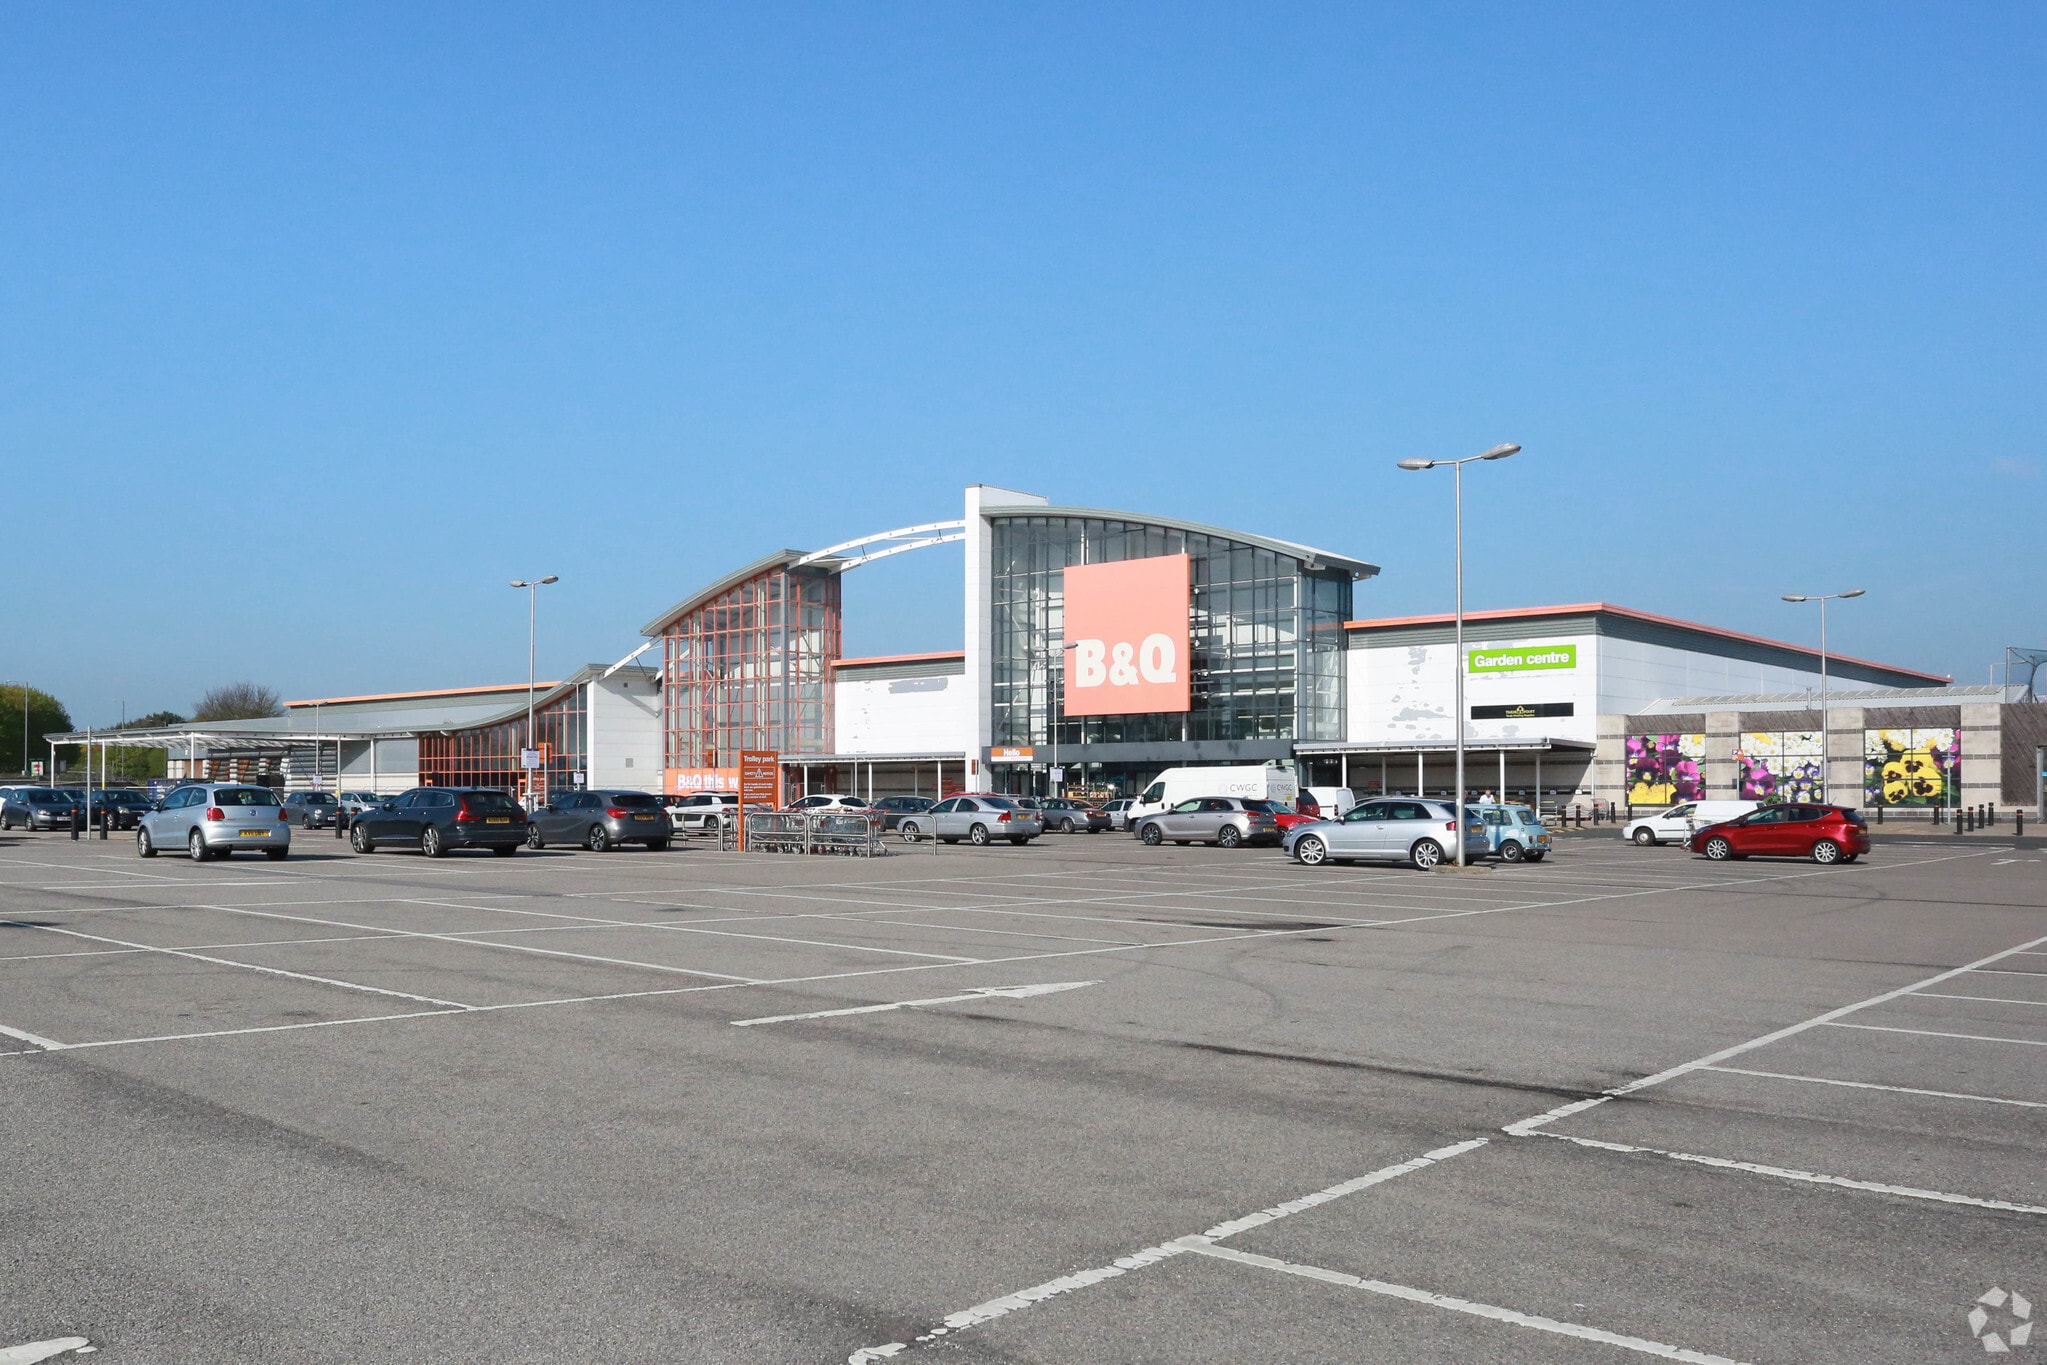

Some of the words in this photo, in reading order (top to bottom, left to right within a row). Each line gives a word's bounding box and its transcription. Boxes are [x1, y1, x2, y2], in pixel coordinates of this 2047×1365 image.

[1075, 633, 1177, 688] B&Q
[1474, 654, 1523, 667] Garden
[1526, 651, 1570, 665] centre
[743, 755, 761, 764] Trolley
[762, 756, 774, 764] park
[677, 774, 702, 789] B&Q
[704, 774, 724, 789] this
[1230, 784, 1257, 792] CWGC
[1277, 784, 1292, 792] CWGC
